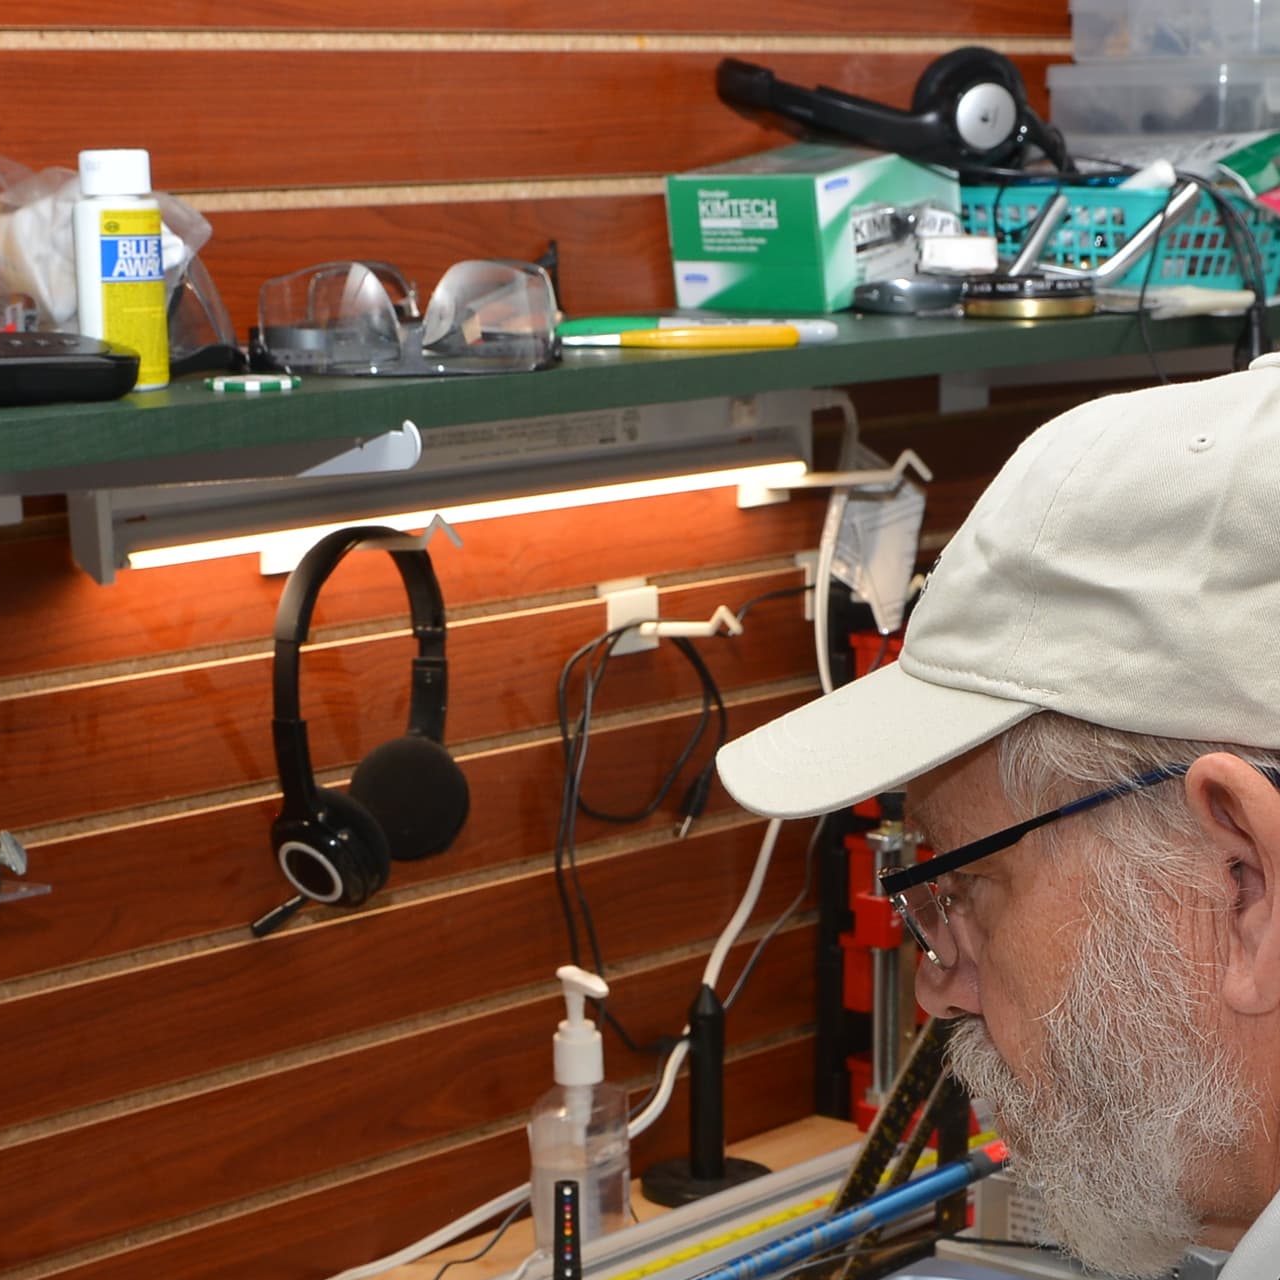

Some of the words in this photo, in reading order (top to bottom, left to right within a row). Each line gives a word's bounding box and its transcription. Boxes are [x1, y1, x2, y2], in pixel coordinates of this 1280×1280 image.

[699, 199, 778, 218] KIMTECH
[117, 239, 160, 259] BLUE
[112, 258, 161, 278] AWAY
